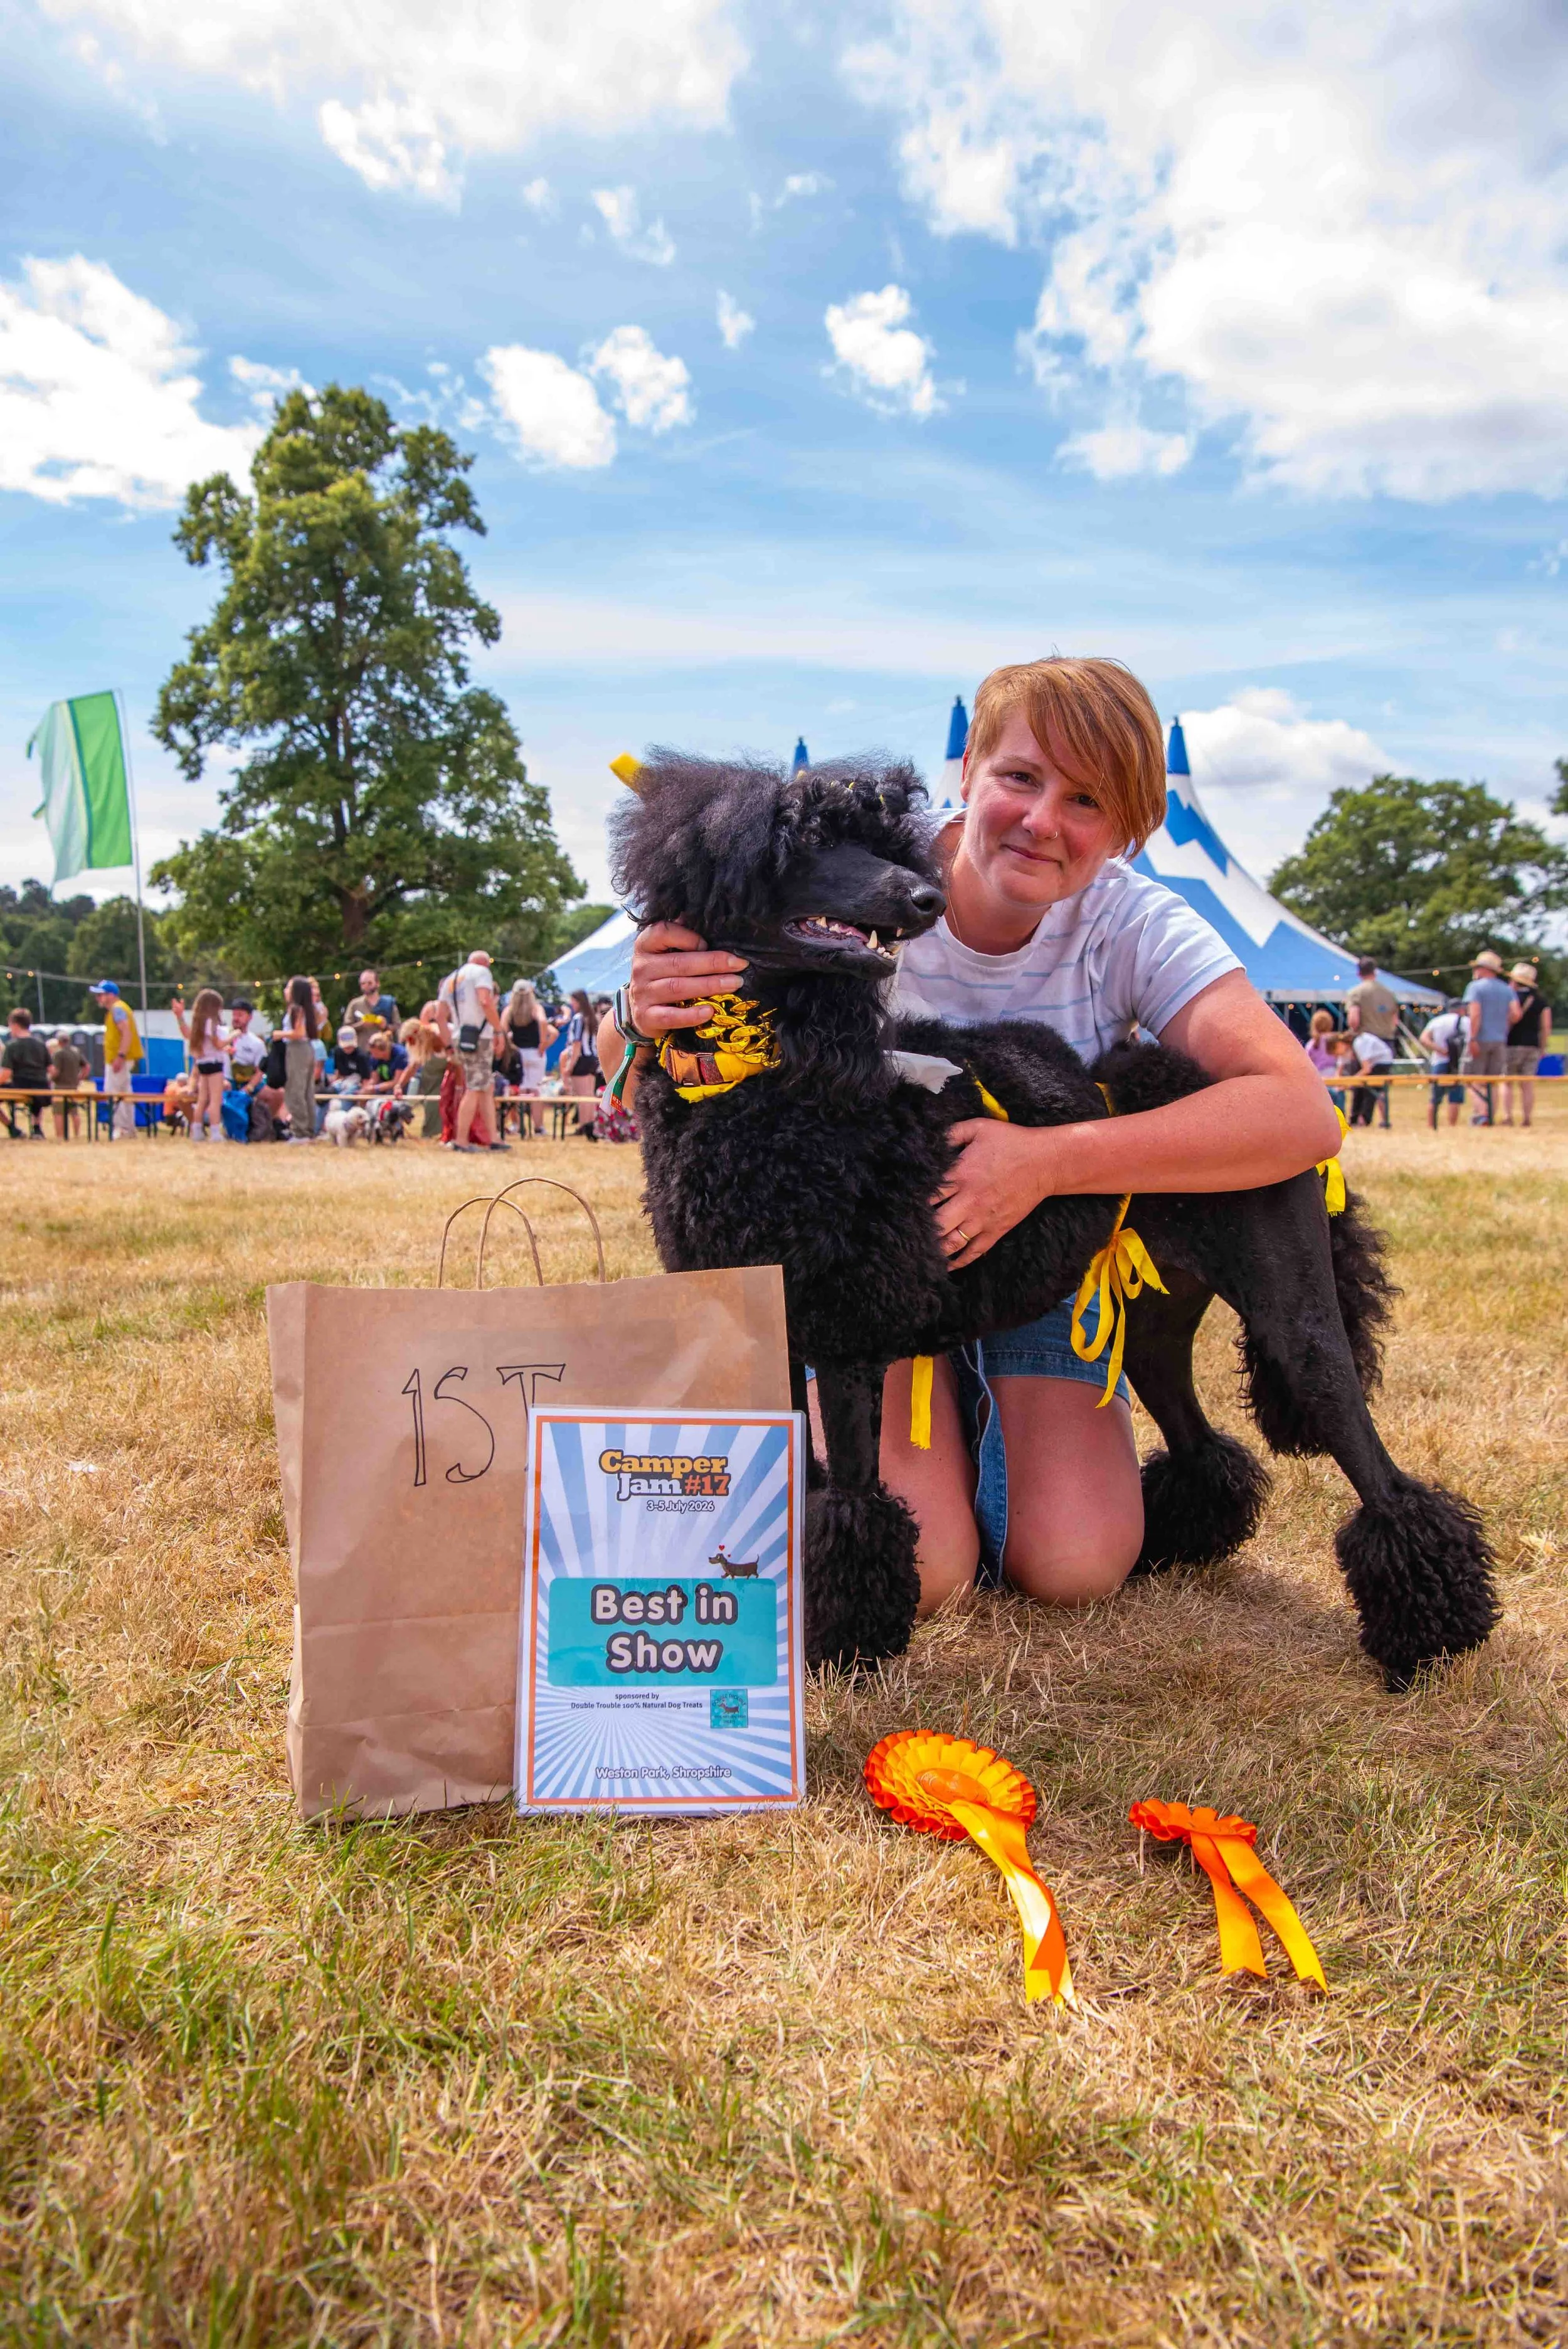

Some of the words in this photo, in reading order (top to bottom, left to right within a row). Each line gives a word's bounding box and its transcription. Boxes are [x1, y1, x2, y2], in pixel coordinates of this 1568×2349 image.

[600, 1450, 728, 1479] Camper
[618, 1473, 682, 1500] Jam
[684, 1475, 730, 1495] #17
[647, 1500, 665, 1512] 3-5
[666, 1500, 687, 1514] July
[688, 1500, 715, 1512] 2026
[593, 1586, 685, 1623] Best
[697, 1585, 735, 1622] in
[608, 1633, 720, 1670] Show
[596, 1767, 638, 1779] Weston
[640, 1766, 670, 1780] Park,
[672, 1765, 731, 1780] Shropshire
